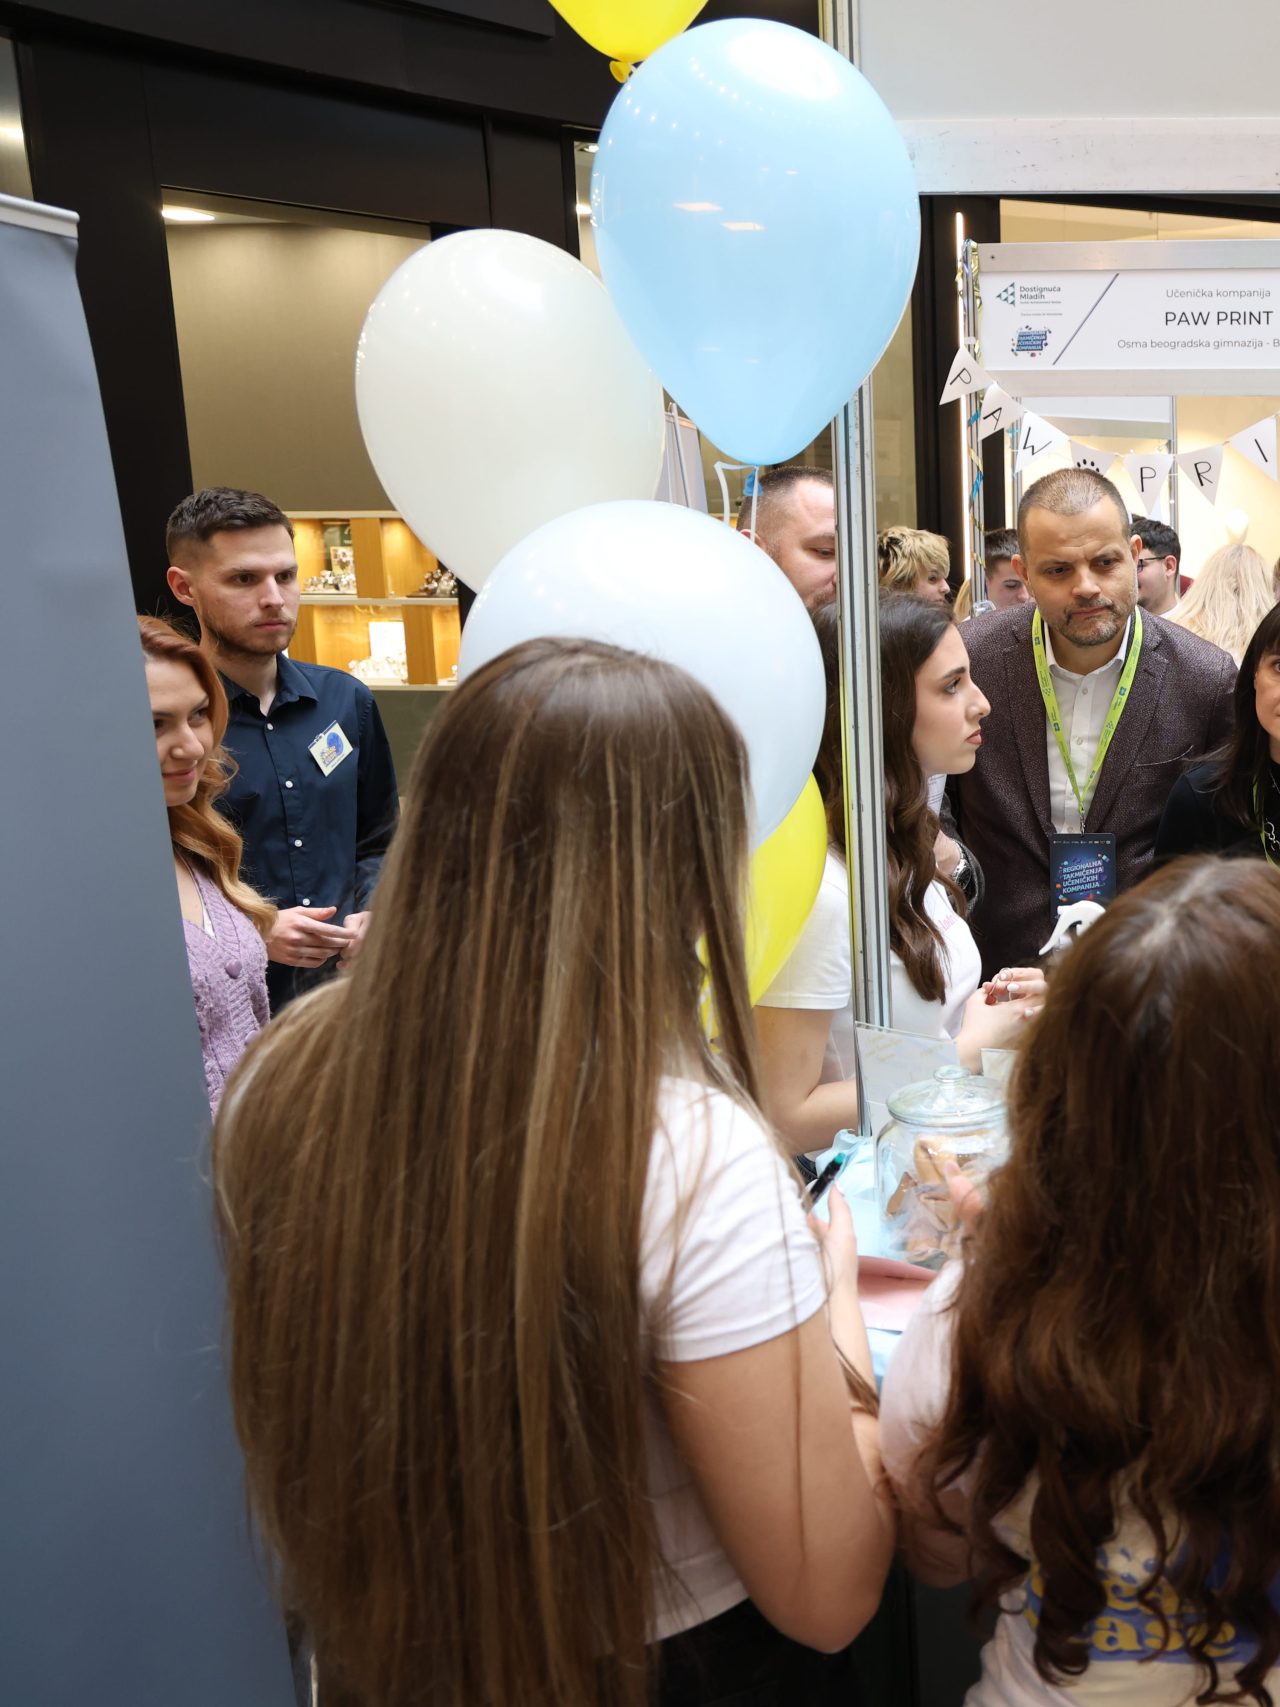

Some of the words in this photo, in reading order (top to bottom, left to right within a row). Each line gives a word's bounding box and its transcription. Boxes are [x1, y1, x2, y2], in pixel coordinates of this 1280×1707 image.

[1019, 285, 1062, 293] Dostignuća
[1166, 288, 1213, 298] Učenička
[1216, 288, 1271, 300] kompanija
[1164, 311, 1210, 326] PAW
[1216, 310, 1274, 326] PRINT
[1117, 339, 1148, 349] Osma
[1150, 339, 1211, 350] beogradska
[1213, 338, 1263, 350] gimnazija
[1062, 866, 1104, 880] TAKMIČENJA
[1062, 874, 1099, 887] UČENIČKIH
[1062, 882, 1100, 894] KOMPANIJA
